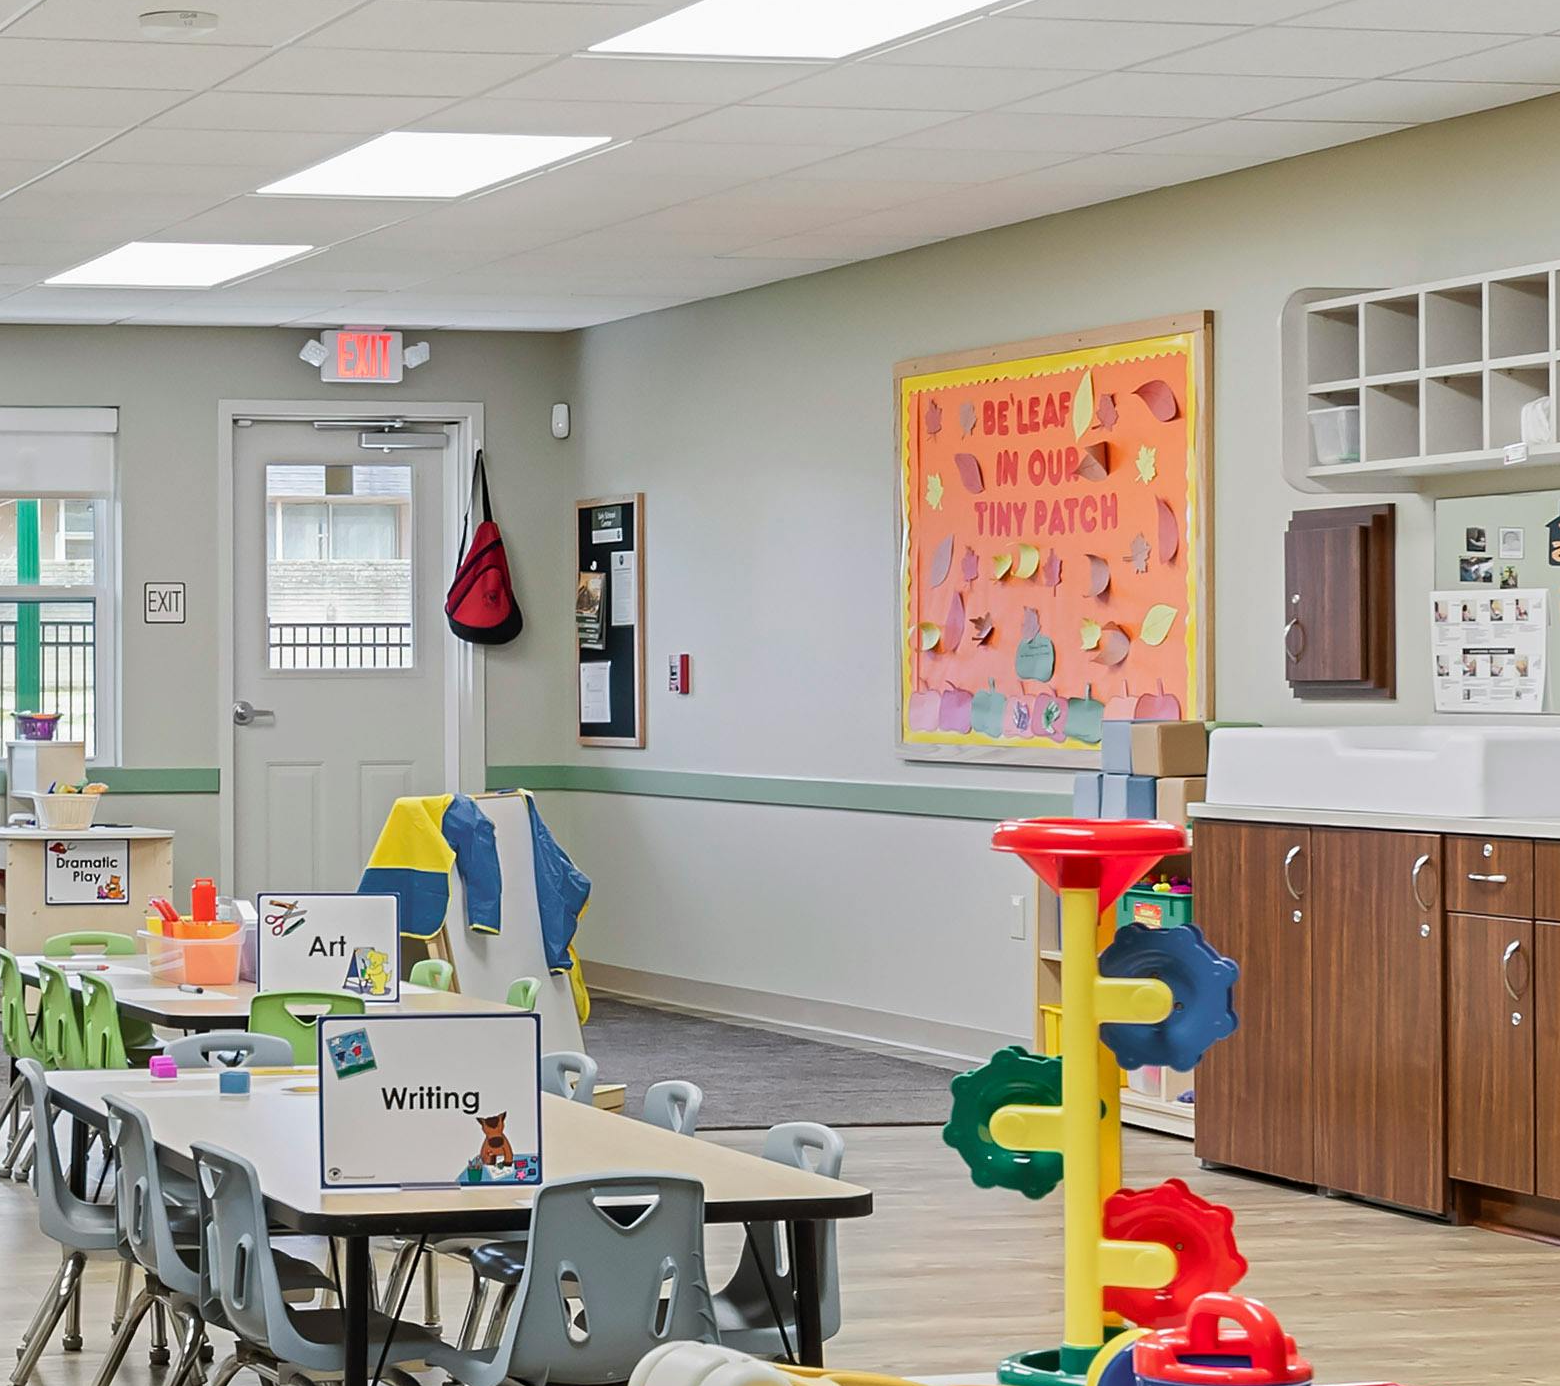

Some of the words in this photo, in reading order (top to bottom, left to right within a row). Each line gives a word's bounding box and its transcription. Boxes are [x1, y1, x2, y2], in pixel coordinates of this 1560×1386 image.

[337, 333, 392, 378] EXIT
[996, 449, 1019, 487] IN
[1027, 446, 1079, 487] OUR
[974, 500, 1027, 537] TINY
[1033, 492, 1118, 536] PATCH
[148, 590, 182, 613] EXIT
[56, 857, 118, 869] Dramatic
[73, 871, 101, 884] Play
[308, 936, 346, 957] Art
[381, 1086, 480, 1115] Writing
